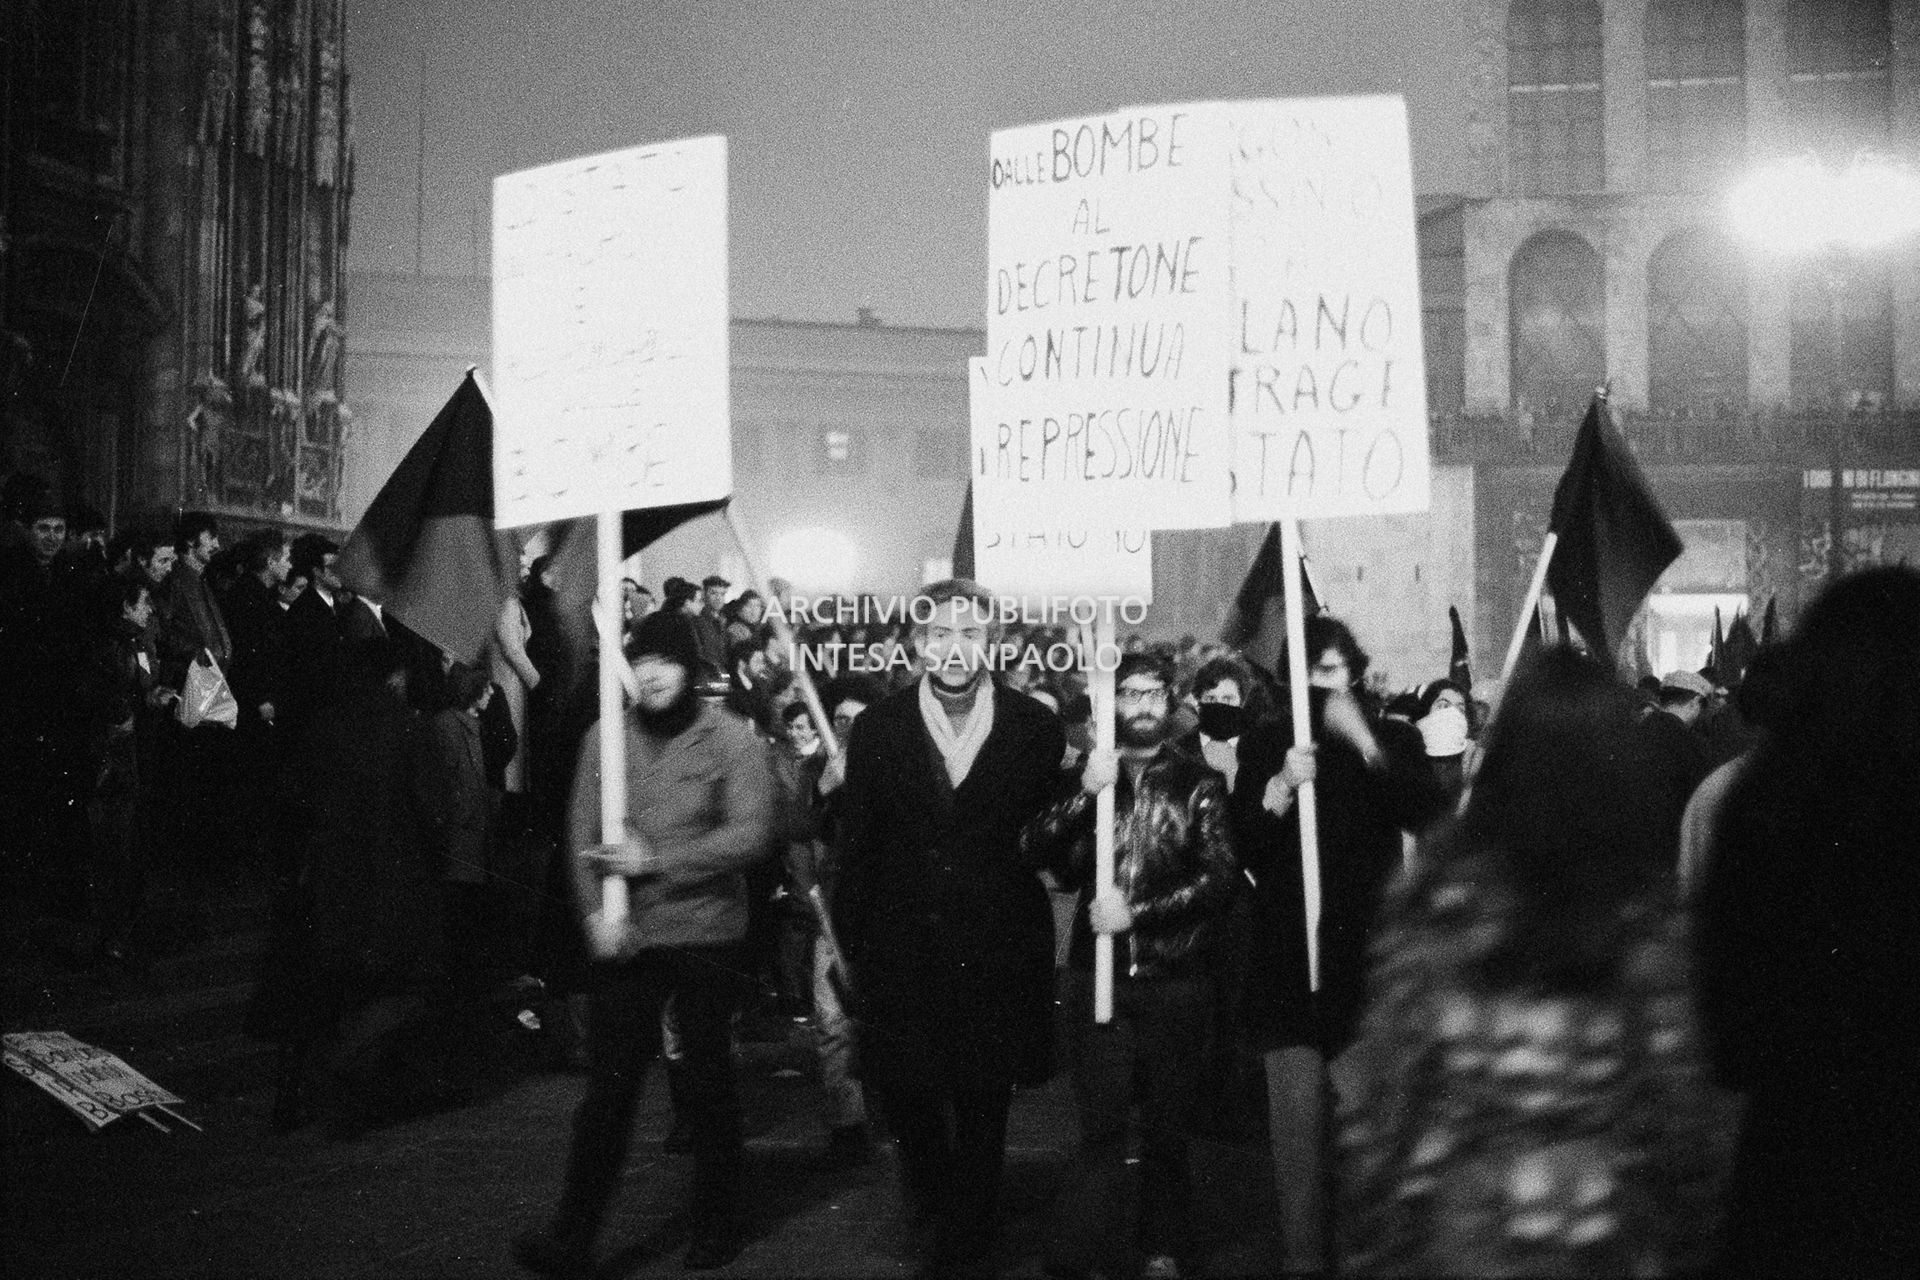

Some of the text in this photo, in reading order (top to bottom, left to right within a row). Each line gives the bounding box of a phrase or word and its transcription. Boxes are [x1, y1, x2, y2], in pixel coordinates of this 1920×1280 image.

[992, 152, 1046, 190] DALLE
[1052, 113, 1188, 183] BOMBE
[1072, 198, 1110, 234] AL
[998, 236, 1203, 316] DECRETONE
[999, 321, 1186, 387] CONTINUA
[997, 406, 1204, 483] REPRESSIONE
